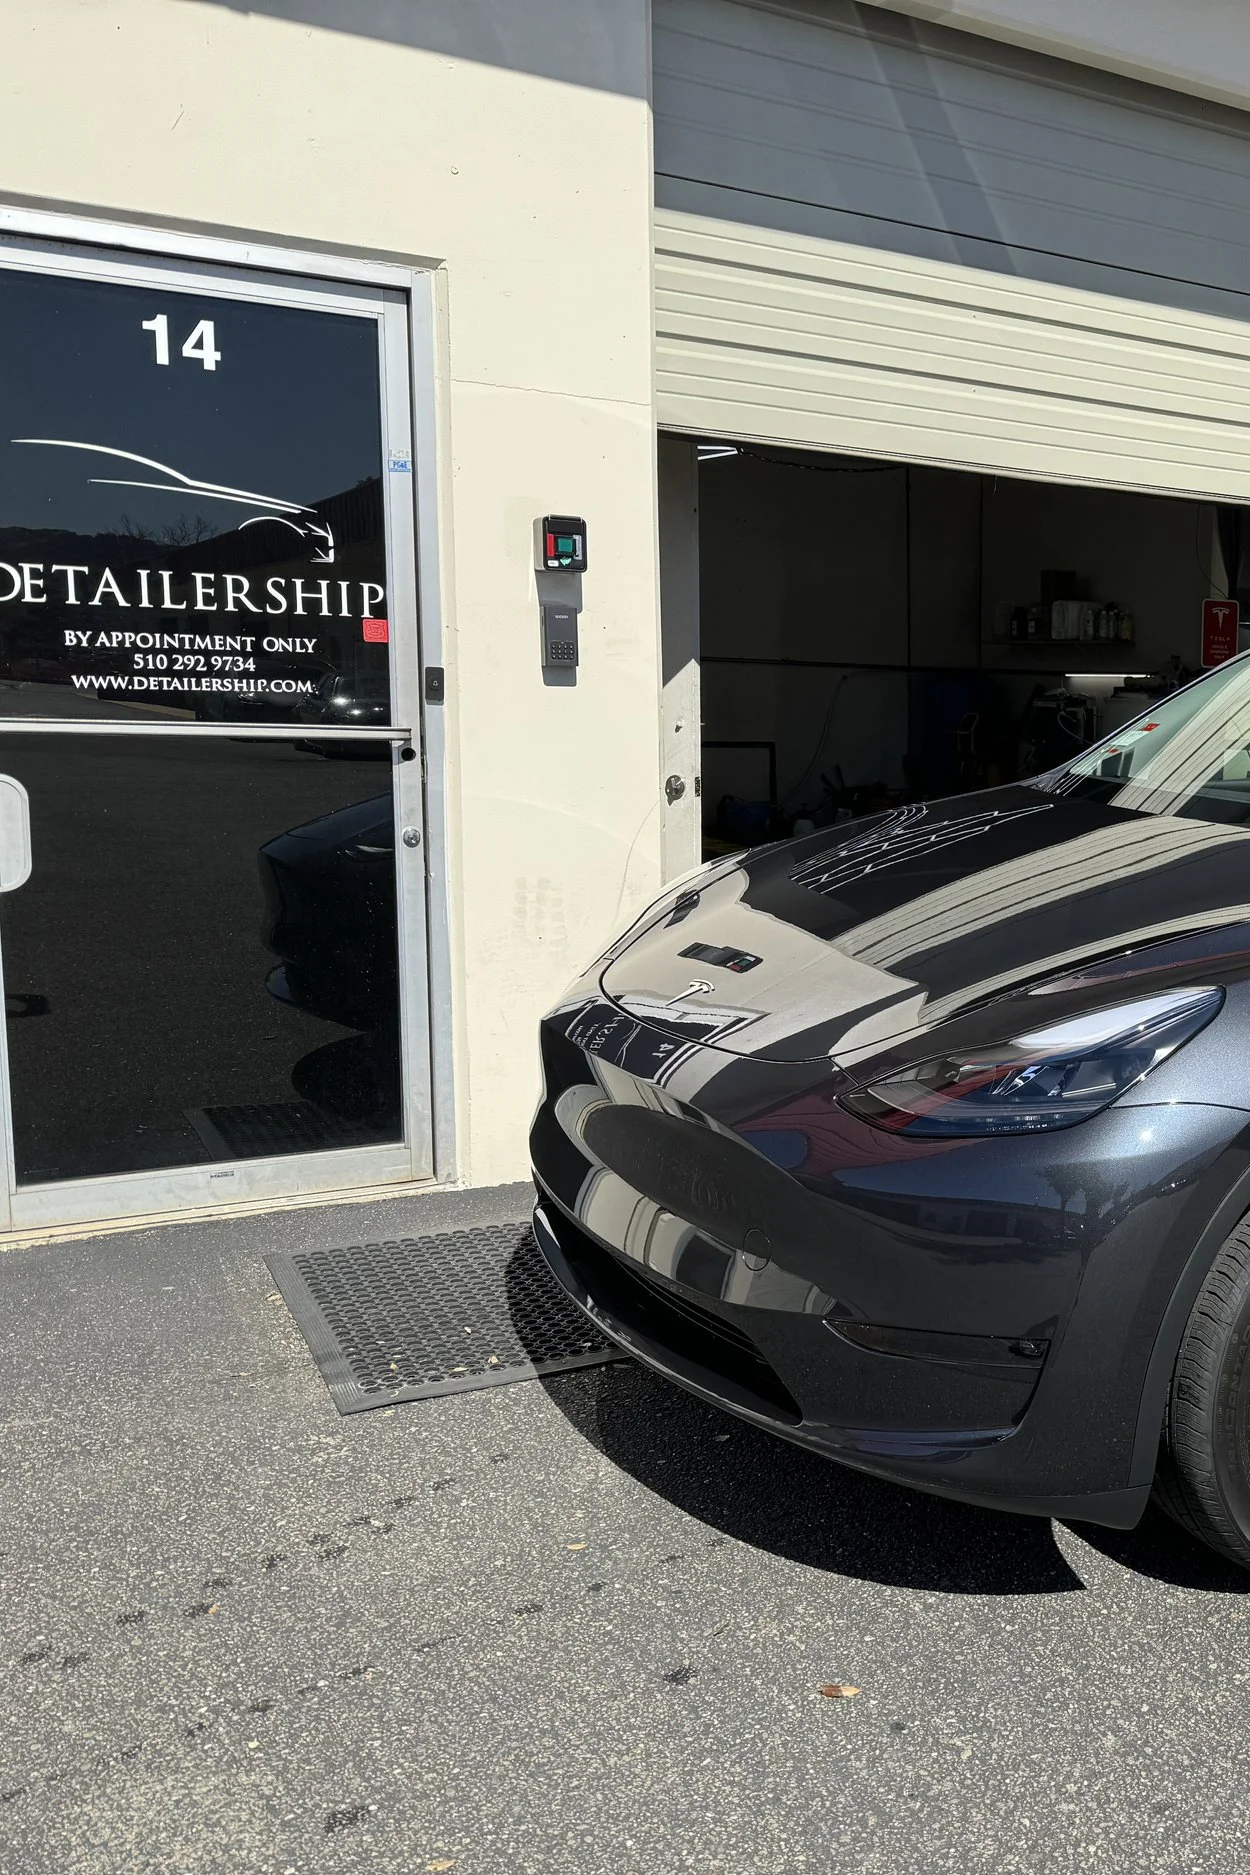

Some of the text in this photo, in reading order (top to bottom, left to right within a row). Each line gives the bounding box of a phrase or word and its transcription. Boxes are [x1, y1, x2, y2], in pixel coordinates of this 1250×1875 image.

[141, 313, 222, 371] 14
[64, 630, 317, 653] BY APPOINTMENT ONLY
[133, 654, 256, 672] 510 292 9734
[71, 675, 314, 693] WWW.DETAILERSHIP.COM
